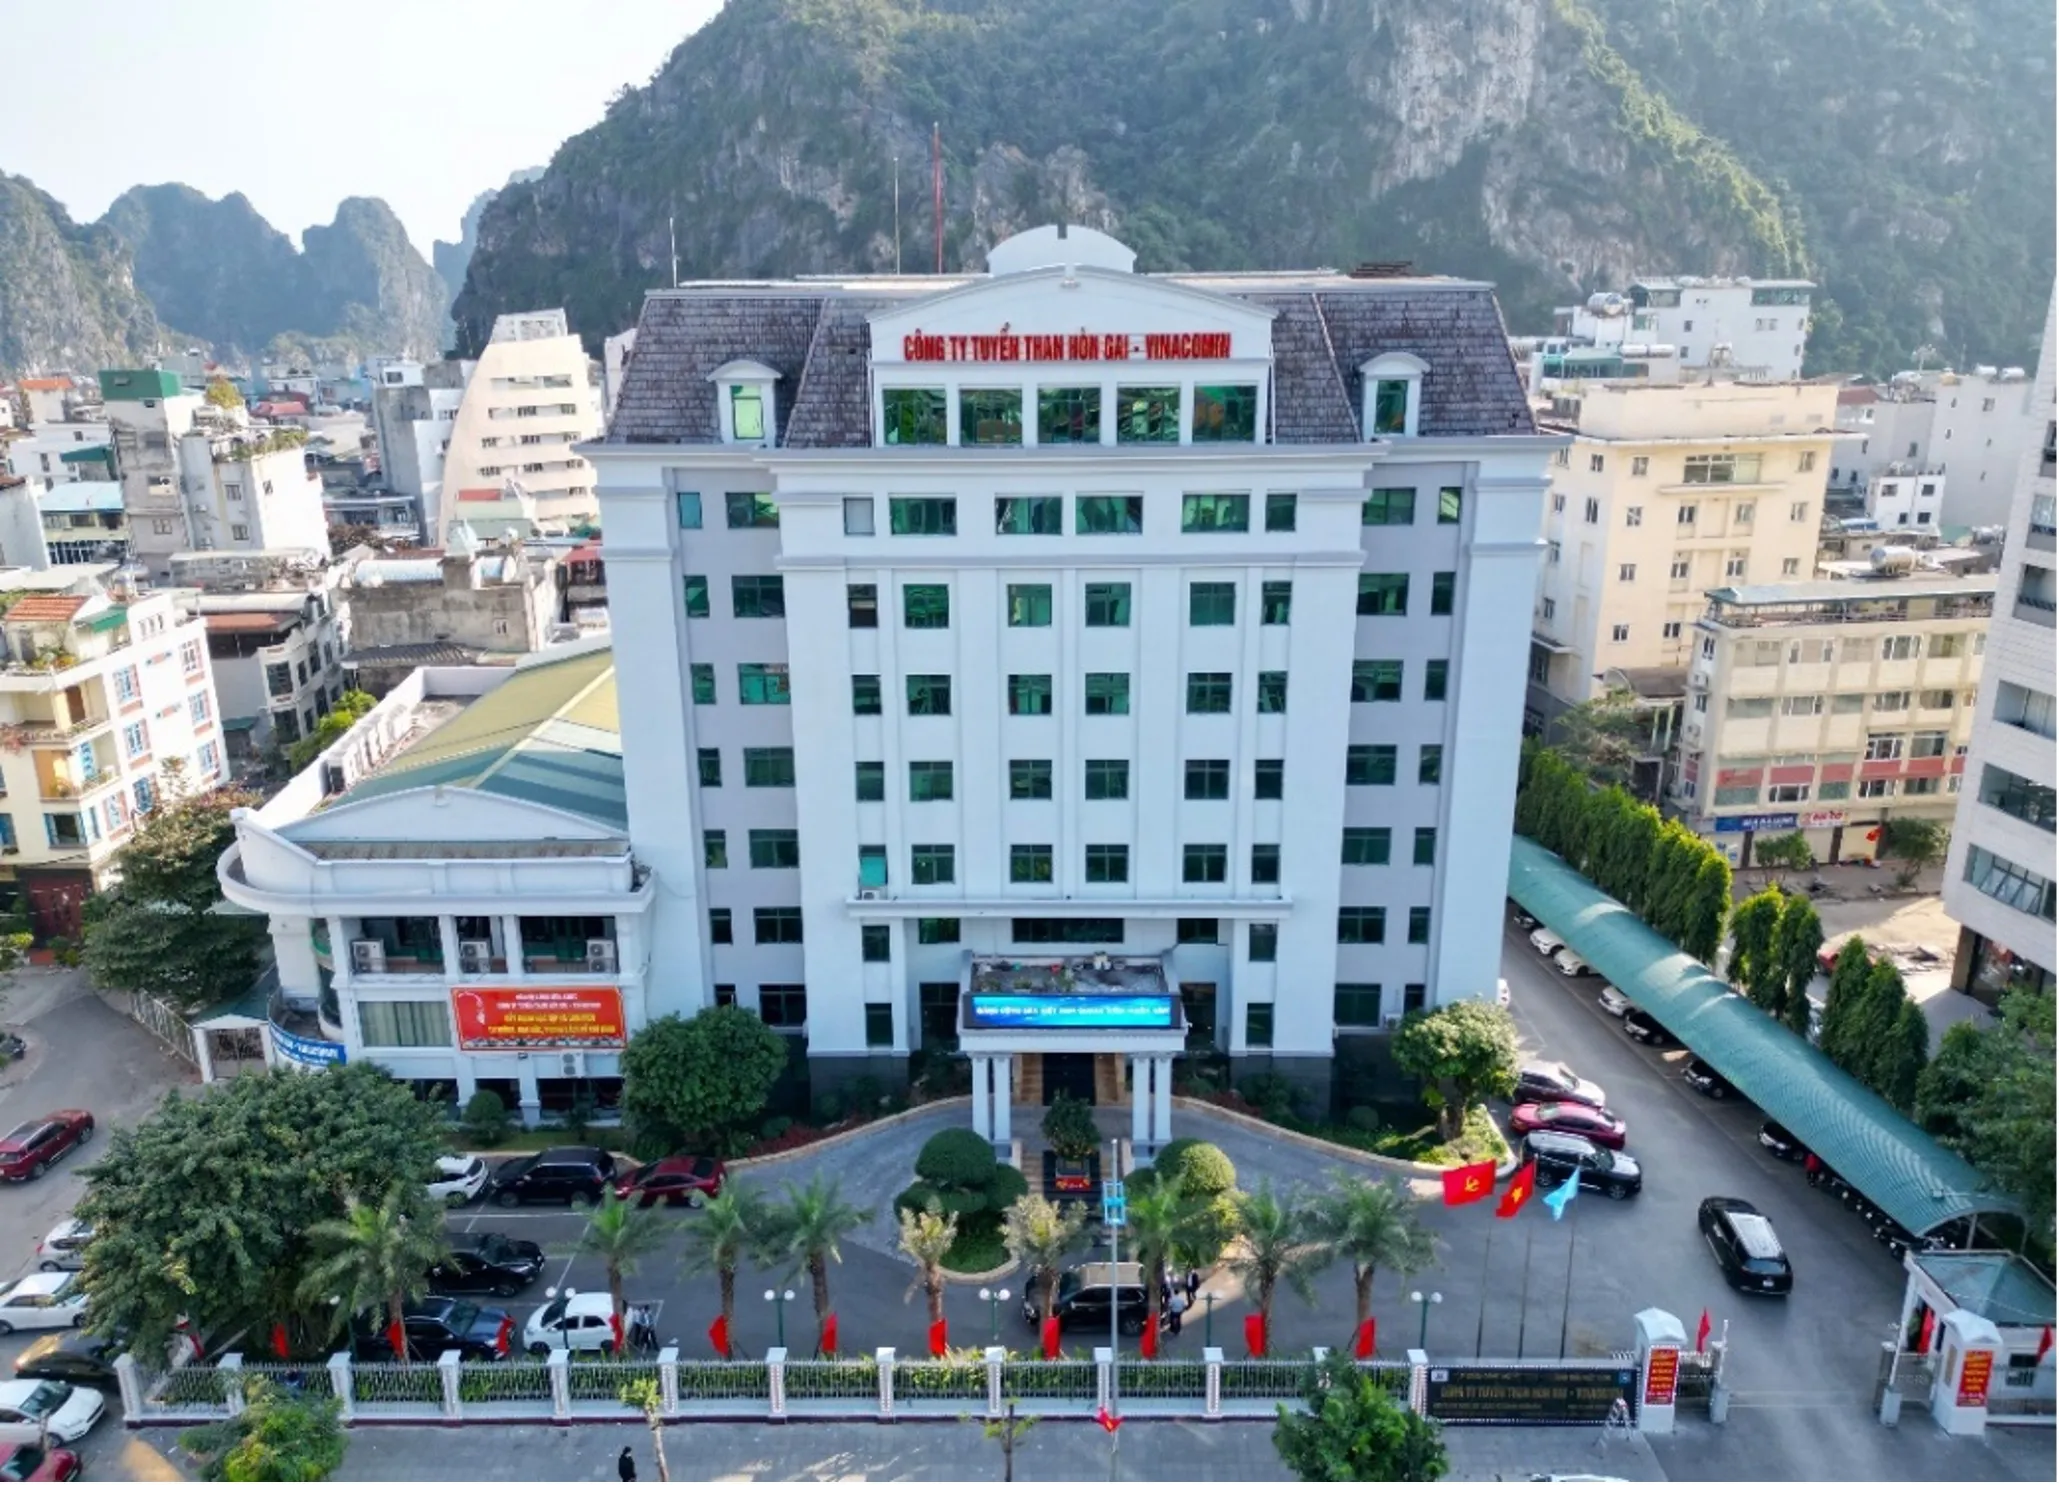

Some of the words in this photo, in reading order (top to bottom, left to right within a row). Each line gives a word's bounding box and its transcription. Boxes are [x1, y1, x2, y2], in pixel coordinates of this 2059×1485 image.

[904, 328, 945, 362] CÔNG
[949, 335, 967, 362] TY
[971, 321, 1019, 361] TUYỂN
[1024, 334, 1064, 361] THAN
[1069, 326, 1098, 361] HÒN
[1104, 334, 1129, 361] GAI
[1146, 332, 1231, 360] VINACOMIN
